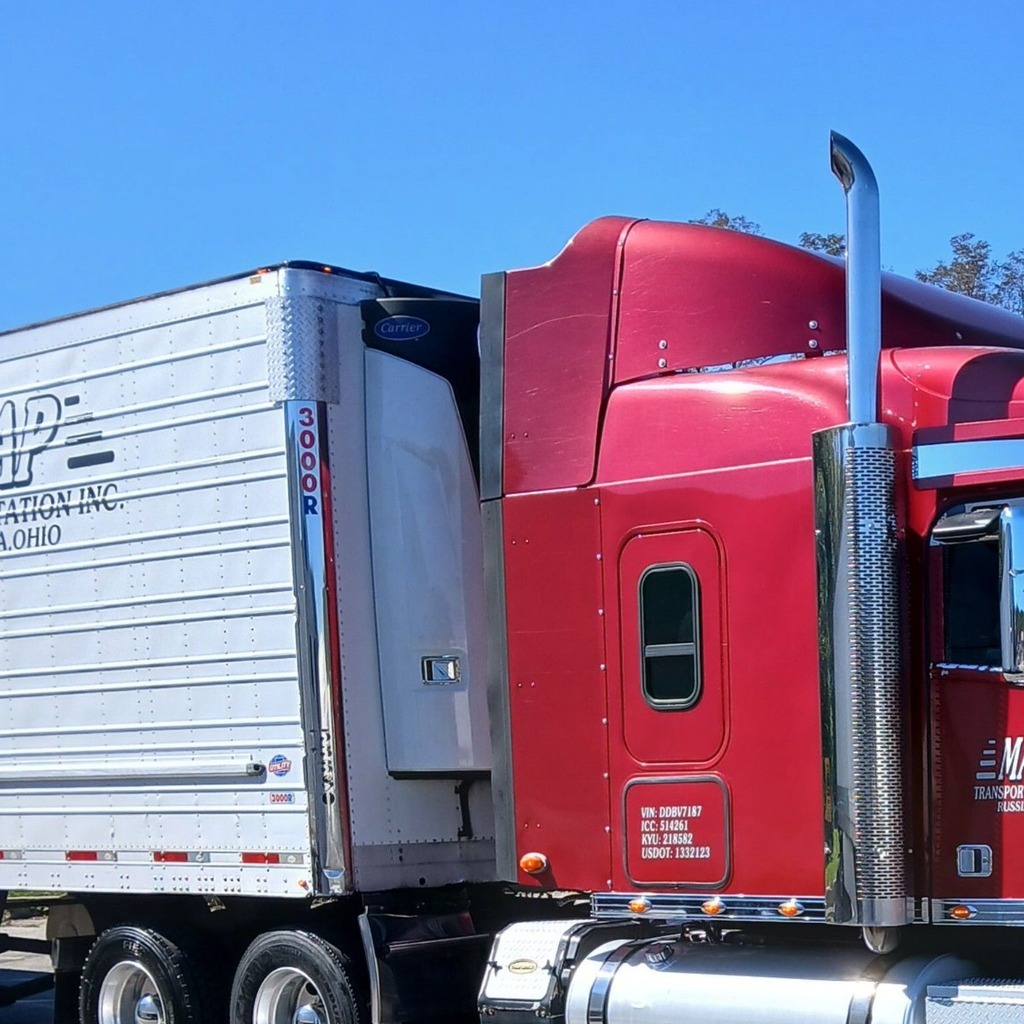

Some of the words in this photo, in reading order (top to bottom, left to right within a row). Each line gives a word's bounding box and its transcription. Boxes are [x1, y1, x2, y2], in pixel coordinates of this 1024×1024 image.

[380, 322, 422, 333] Carrier
[299, 407, 318, 515] 3000R
[79, 483, 125, 514] INC.
[641, 806, 658, 818] VIN:
[659, 806, 702, 818] DDBV7187
[641, 820, 658, 832] ICC:
[660, 820, 688, 831] 514261
[641, 834, 661, 845] KYU:
[663, 833, 693, 845] 218582
[641, 847, 673, 859] USDOT:
[675, 846, 710, 859] 1332123
